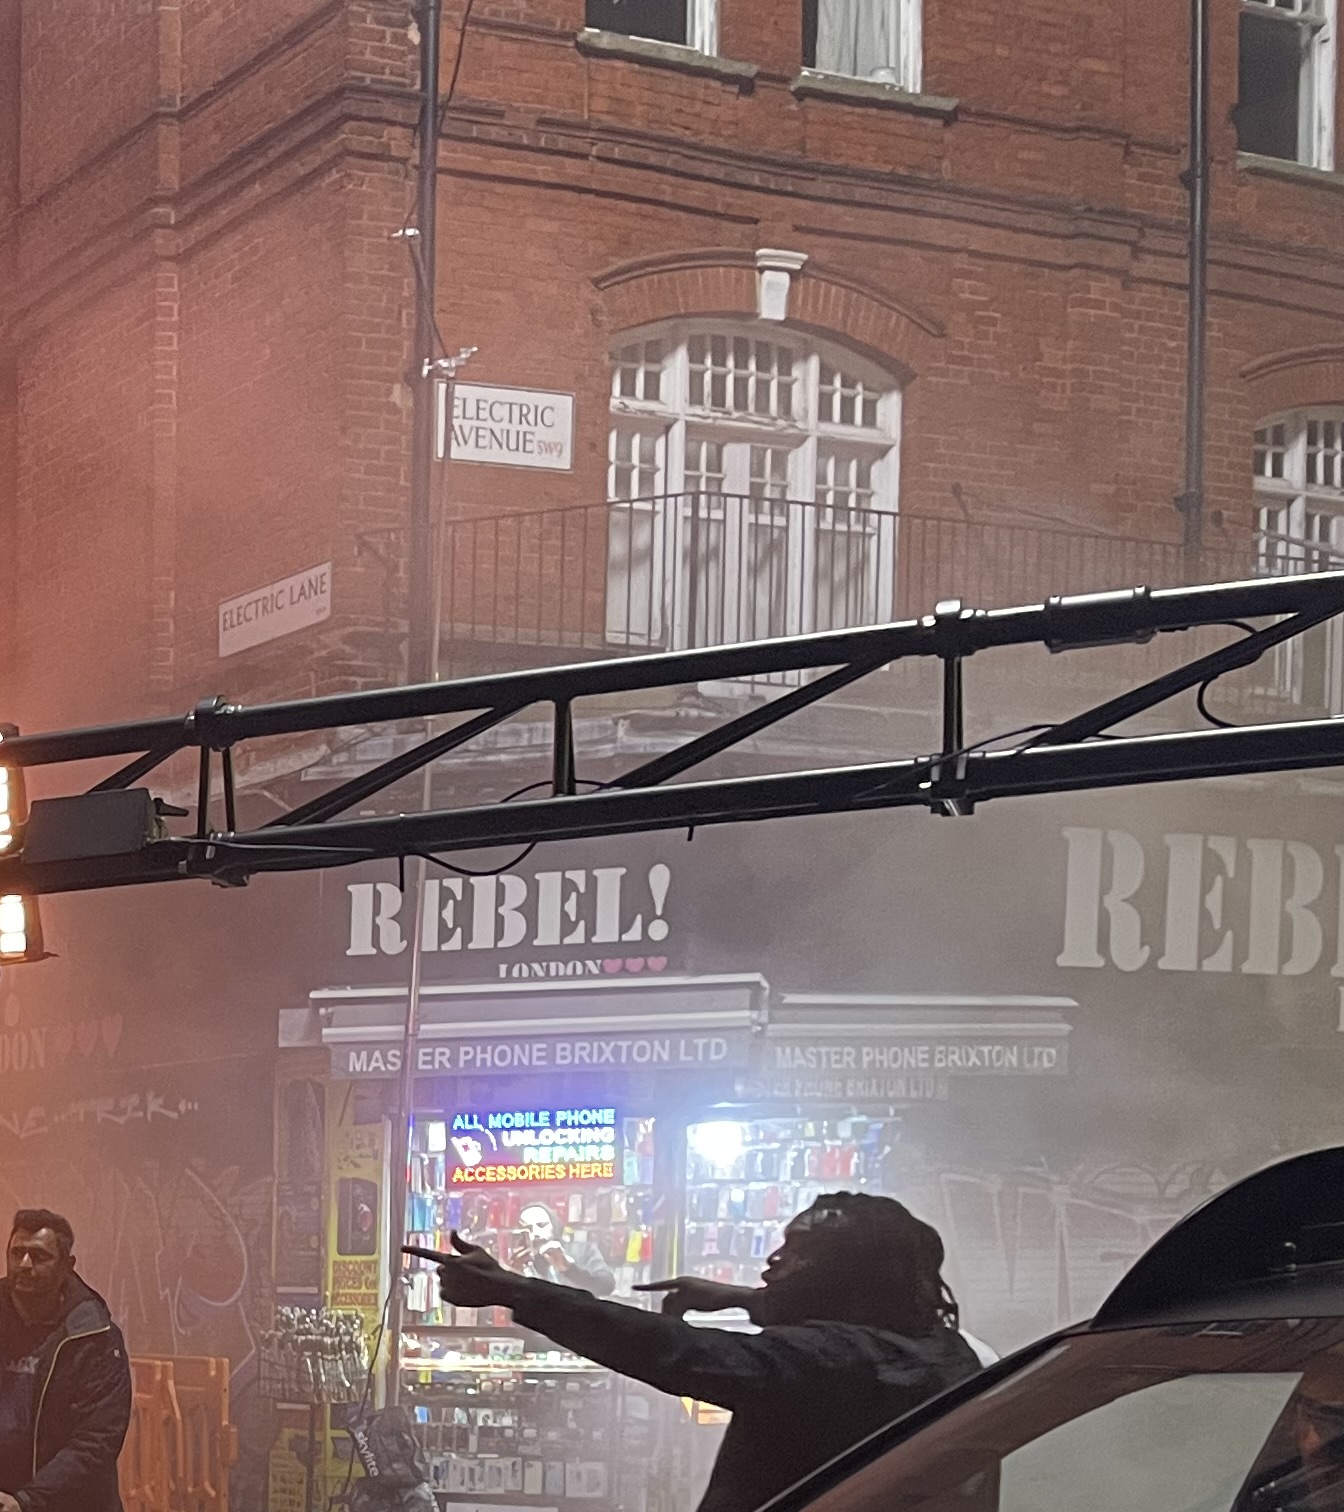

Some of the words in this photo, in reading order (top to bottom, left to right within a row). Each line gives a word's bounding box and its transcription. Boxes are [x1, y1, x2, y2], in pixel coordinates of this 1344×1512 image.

[452, 396, 555, 428] ELECTRIC
[222, 588, 285, 632] ELECTRIC
[289, 571, 327, 606] LANE
[346, 863, 672, 956] REBEL!
[1056, 826, 1344, 978] REB
[498, 960, 603, 978] LONDON
[348, 1046, 452, 1072] MASER
[459, 1043, 547, 1069] PHONE
[555, 1039, 671, 1066] BRIXTON
[679, 1037, 728, 1061] LTD
[775, 1046, 856, 1069] MASTER
[861, 1046, 930, 1068] PHONE
[933, 1045, 1018, 1068] BRIXTON
[1023, 1047, 1058, 1068] LTD
[452, 1114, 483, 1130] ALL
[488, 1111, 551, 1129] MOBILE
[556, 1108, 616, 1127] PHONE
[501, 1126, 616, 1147] UNLOCKING
[523, 1144, 616, 1164] REPAIRS
[452, 1163, 566, 1183] ACCESSORIES
[568, 1162, 614, 1179] HERE
[357, 1431, 380, 1478] skylite
